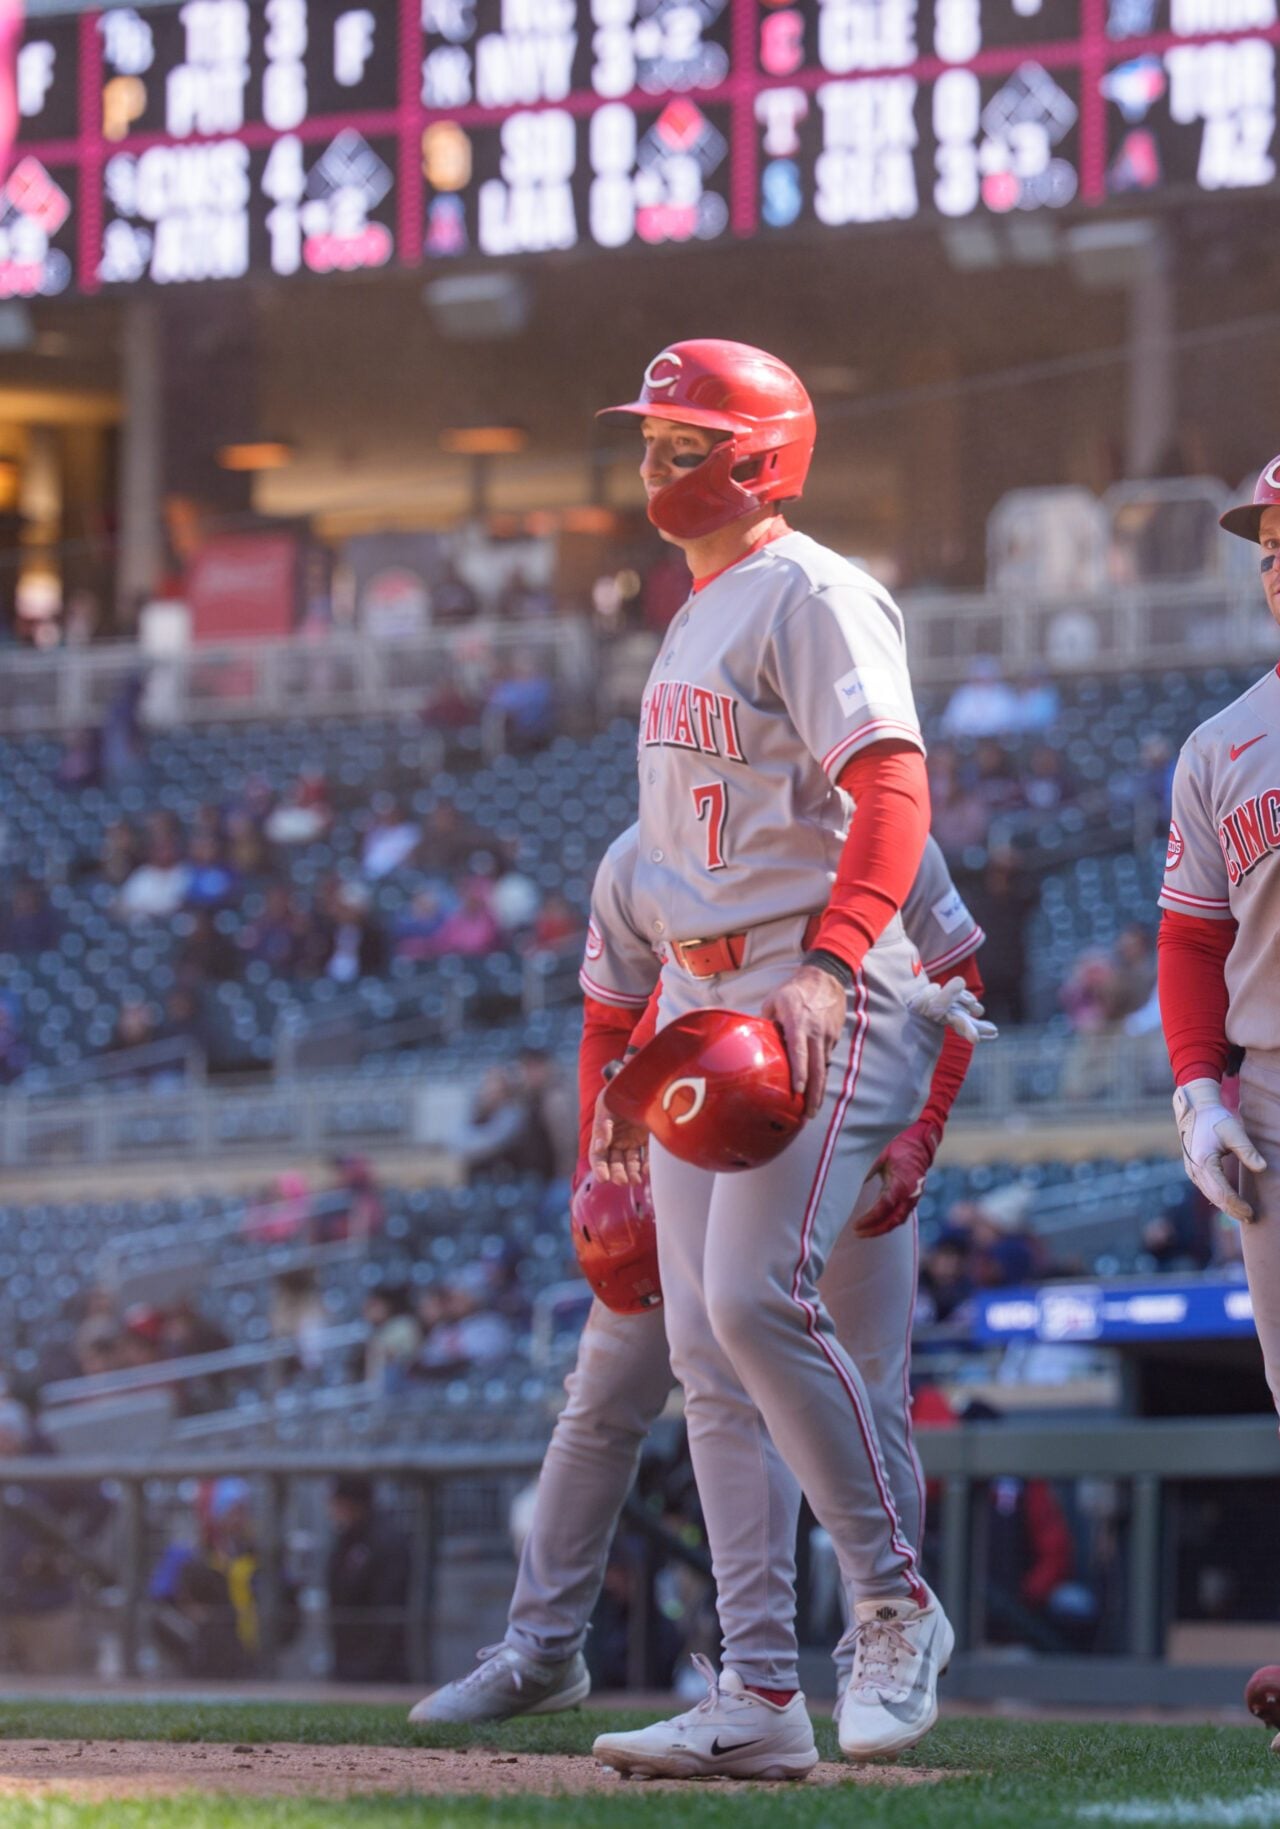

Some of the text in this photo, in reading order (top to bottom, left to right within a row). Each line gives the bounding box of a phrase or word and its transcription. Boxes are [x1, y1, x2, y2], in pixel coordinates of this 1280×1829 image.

[334, 10, 376, 86] F
[643, 352, 683, 388] C
[690, 779, 729, 873] 7
